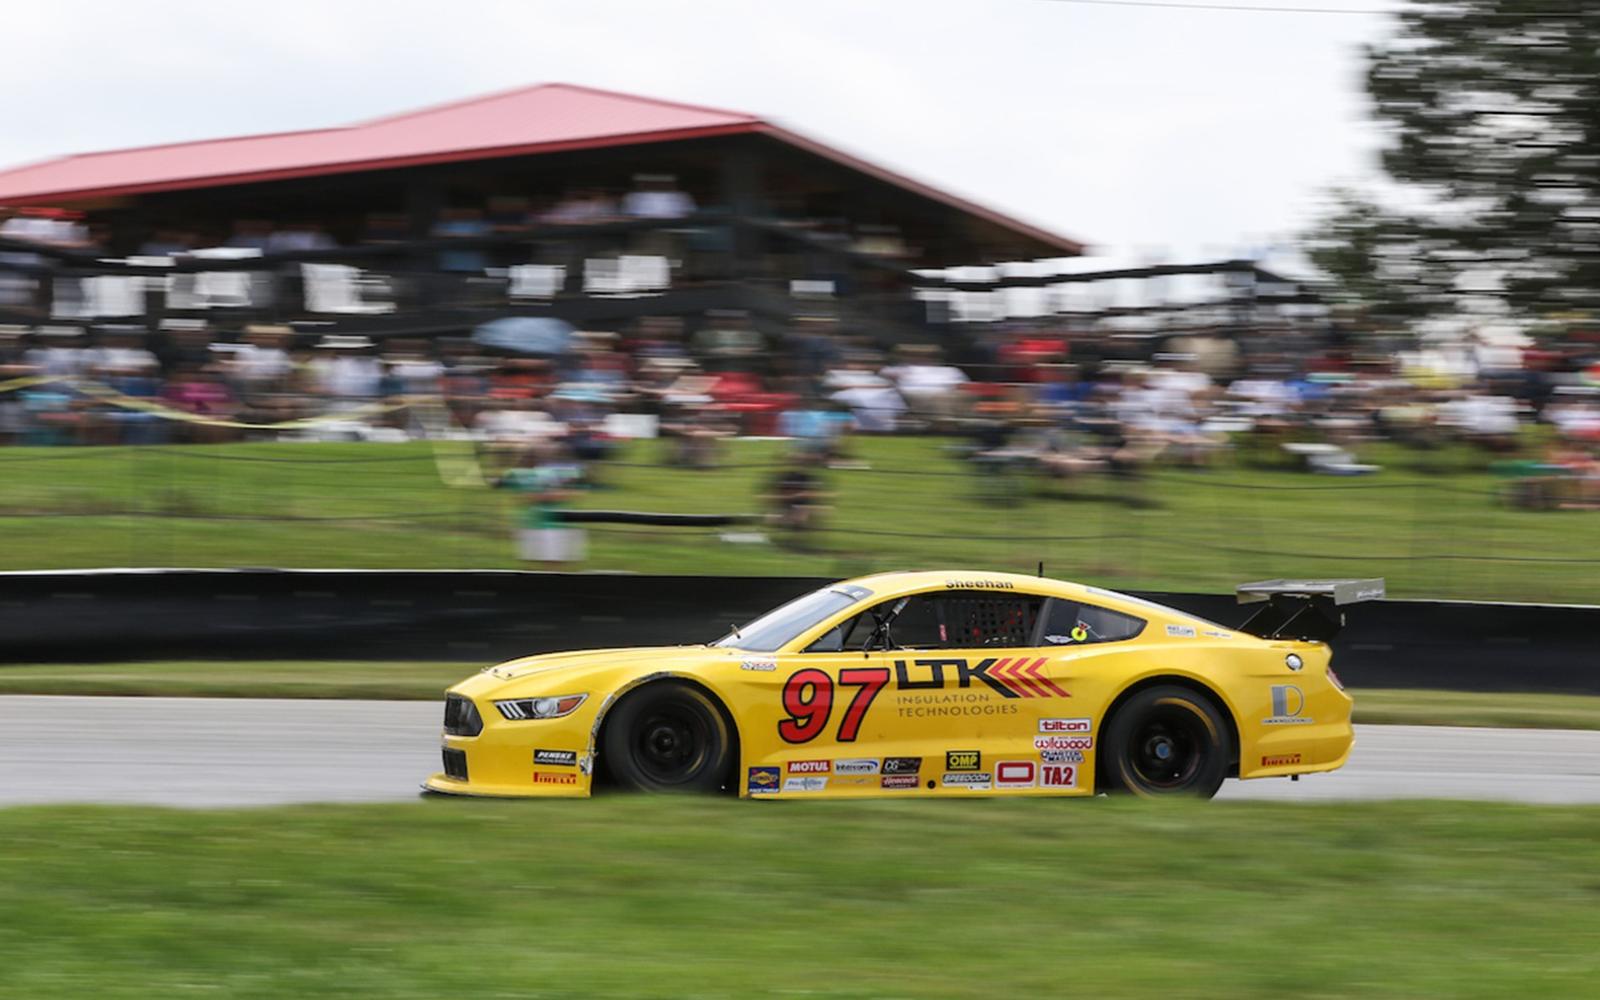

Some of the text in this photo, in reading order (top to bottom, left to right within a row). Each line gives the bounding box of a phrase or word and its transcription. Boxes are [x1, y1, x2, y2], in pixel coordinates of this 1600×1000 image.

[945, 579, 1013, 590] Sheehan
[895, 658, 1022, 698] LTK
[897, 694, 989, 705] INSULATION
[778, 668, 890, 744] 97
[898, 704, 1018, 717] TECHNOLOGIES
[1042, 721, 1088, 731] tilton
[1035, 736, 1093, 749] wilwood
[538, 751, 573, 759] PENSKE
[949, 755, 978, 767] OMP
[1262, 753, 1301, 767] PIRELLI
[789, 761, 829, 772] MOTUL
[533, 772, 577, 784] PIRELLI
[943, 774, 990, 783] SPEEDCOM
[1043, 766, 1073, 785] TA2
